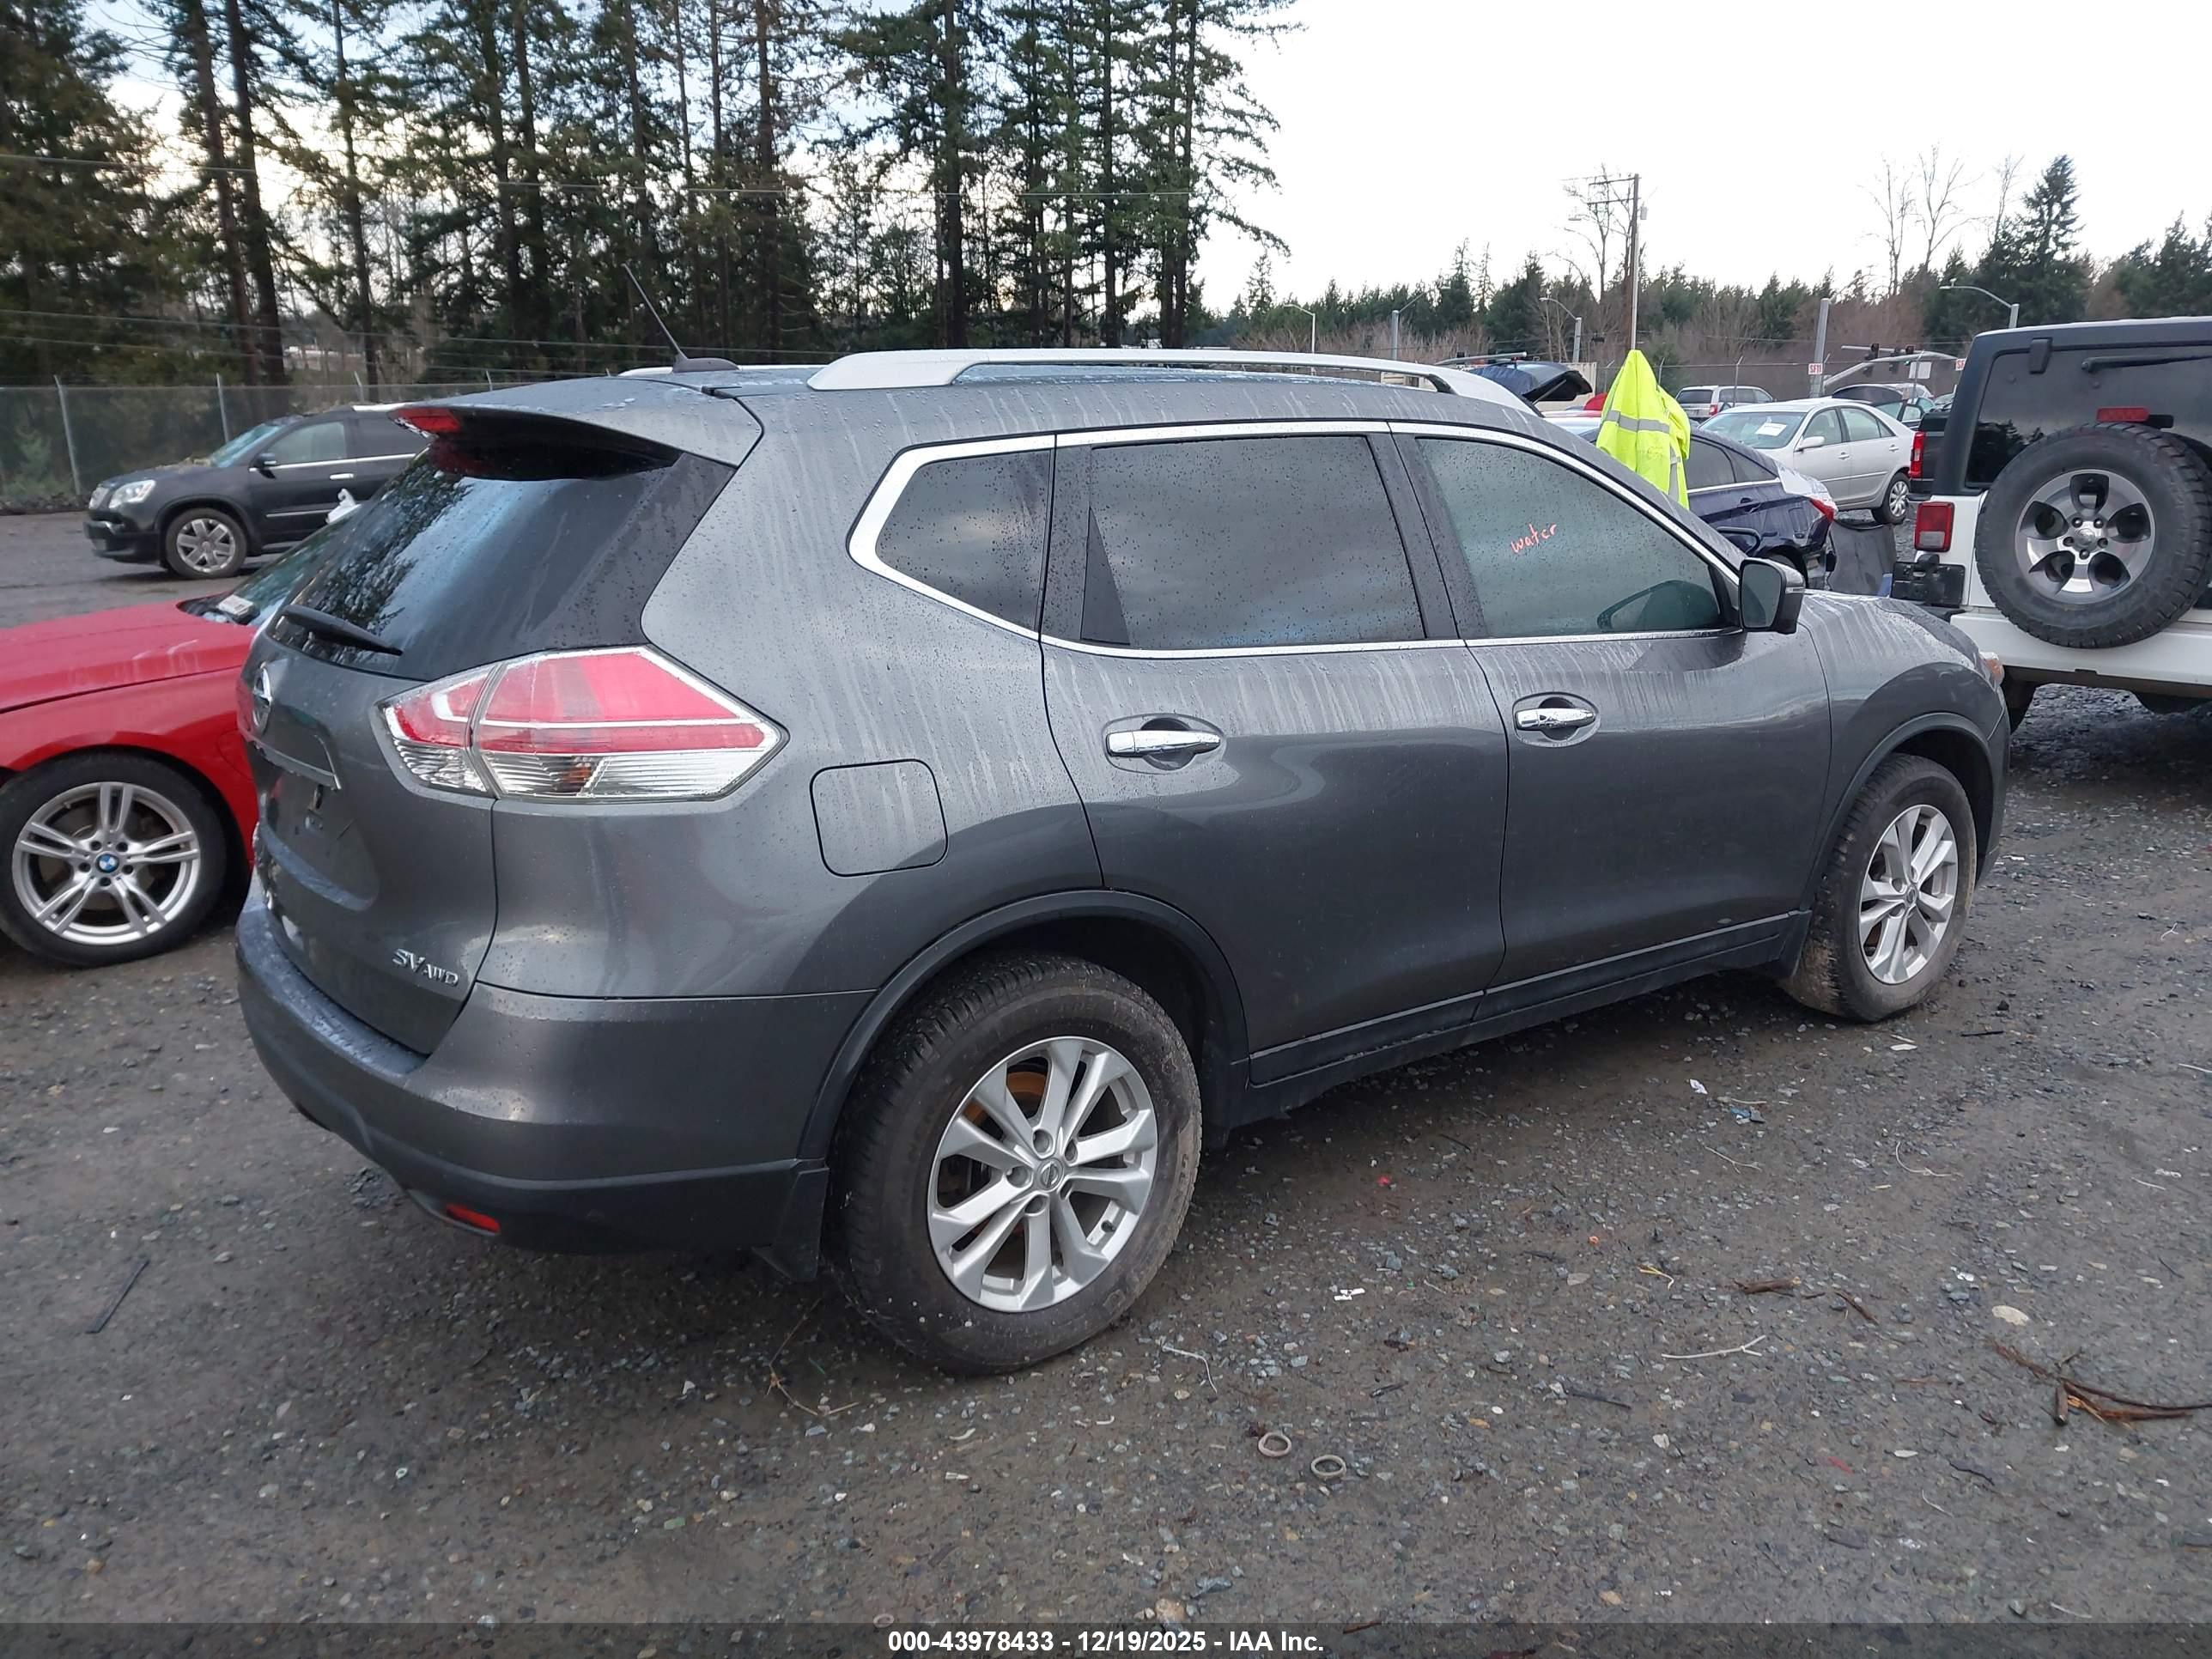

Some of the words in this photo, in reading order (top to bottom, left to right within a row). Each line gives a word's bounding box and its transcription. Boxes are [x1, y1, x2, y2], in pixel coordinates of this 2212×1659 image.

[1510, 523, 1558, 555] water
[392, 948, 426, 973] SV
[422, 963, 459, 987] AWD
